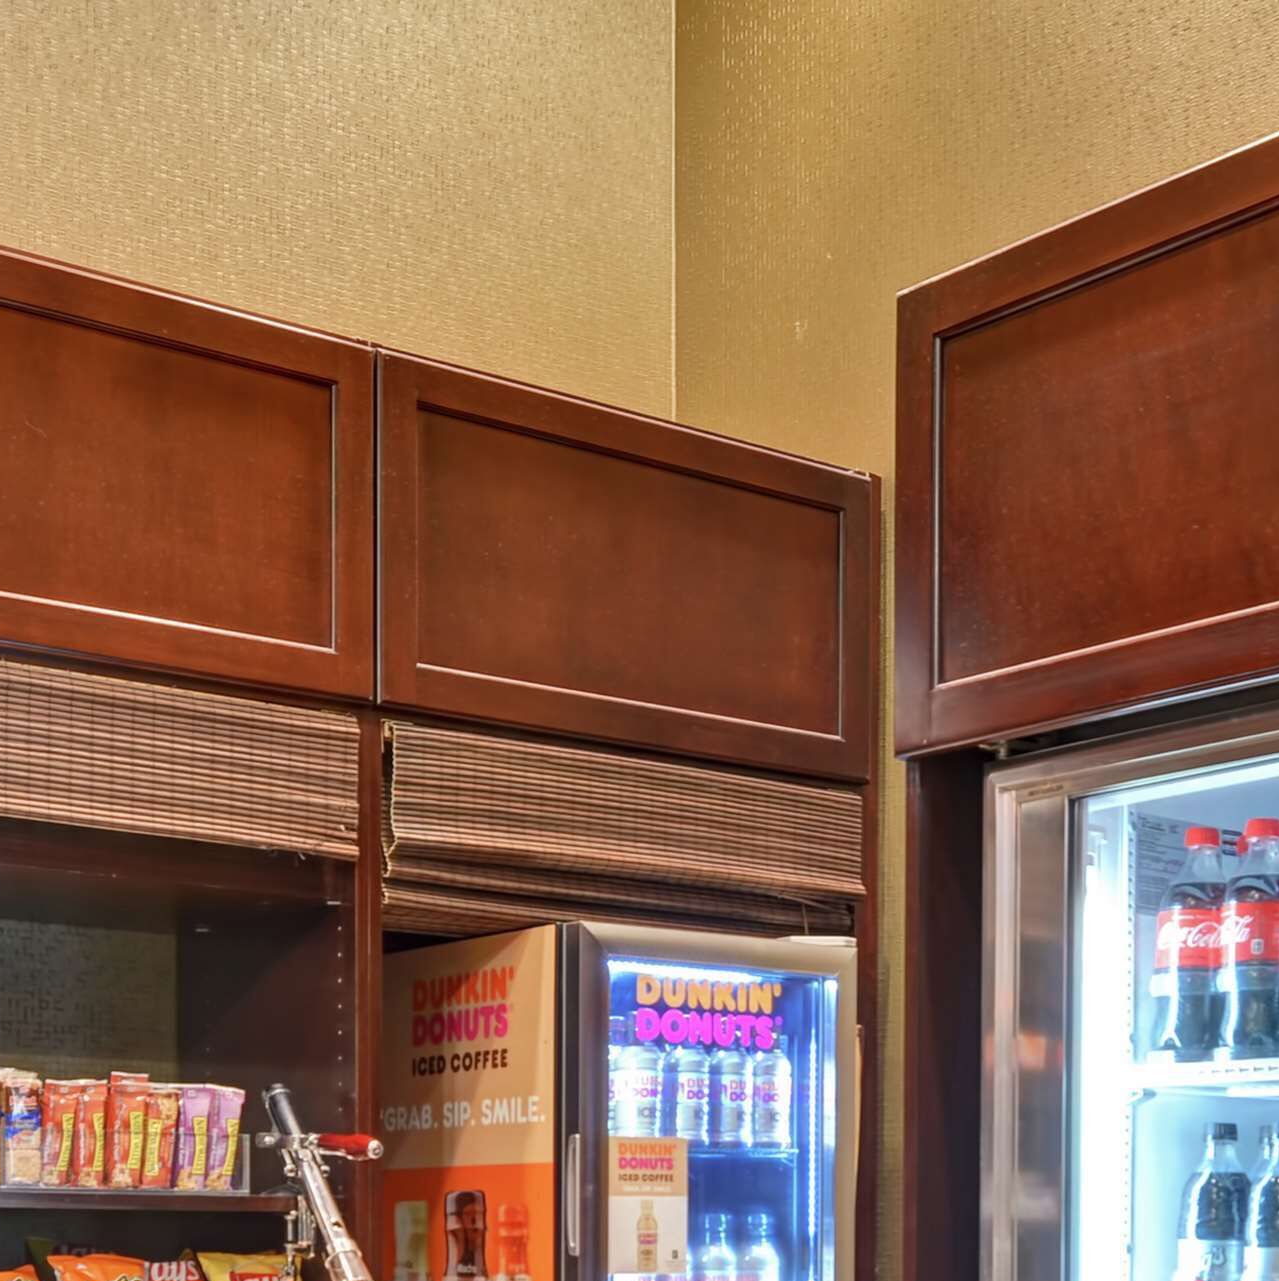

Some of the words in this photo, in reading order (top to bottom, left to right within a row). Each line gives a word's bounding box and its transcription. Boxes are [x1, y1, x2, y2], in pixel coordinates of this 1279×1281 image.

[413, 966, 514, 1012] DUNKIN'
[636, 974, 783, 1015] DUNKIN'
[411, 1003, 508, 1047] DONUTS
[636, 1008, 776, 1050] DONUTS
[412, 1056, 445, 1077] ICED
[450, 1049, 508, 1073] COFFEE
[443, 1100, 476, 1128] SIP.
[481, 1096, 546, 1125] SMILE.
[618, 1157, 674, 1171] DONUTS
